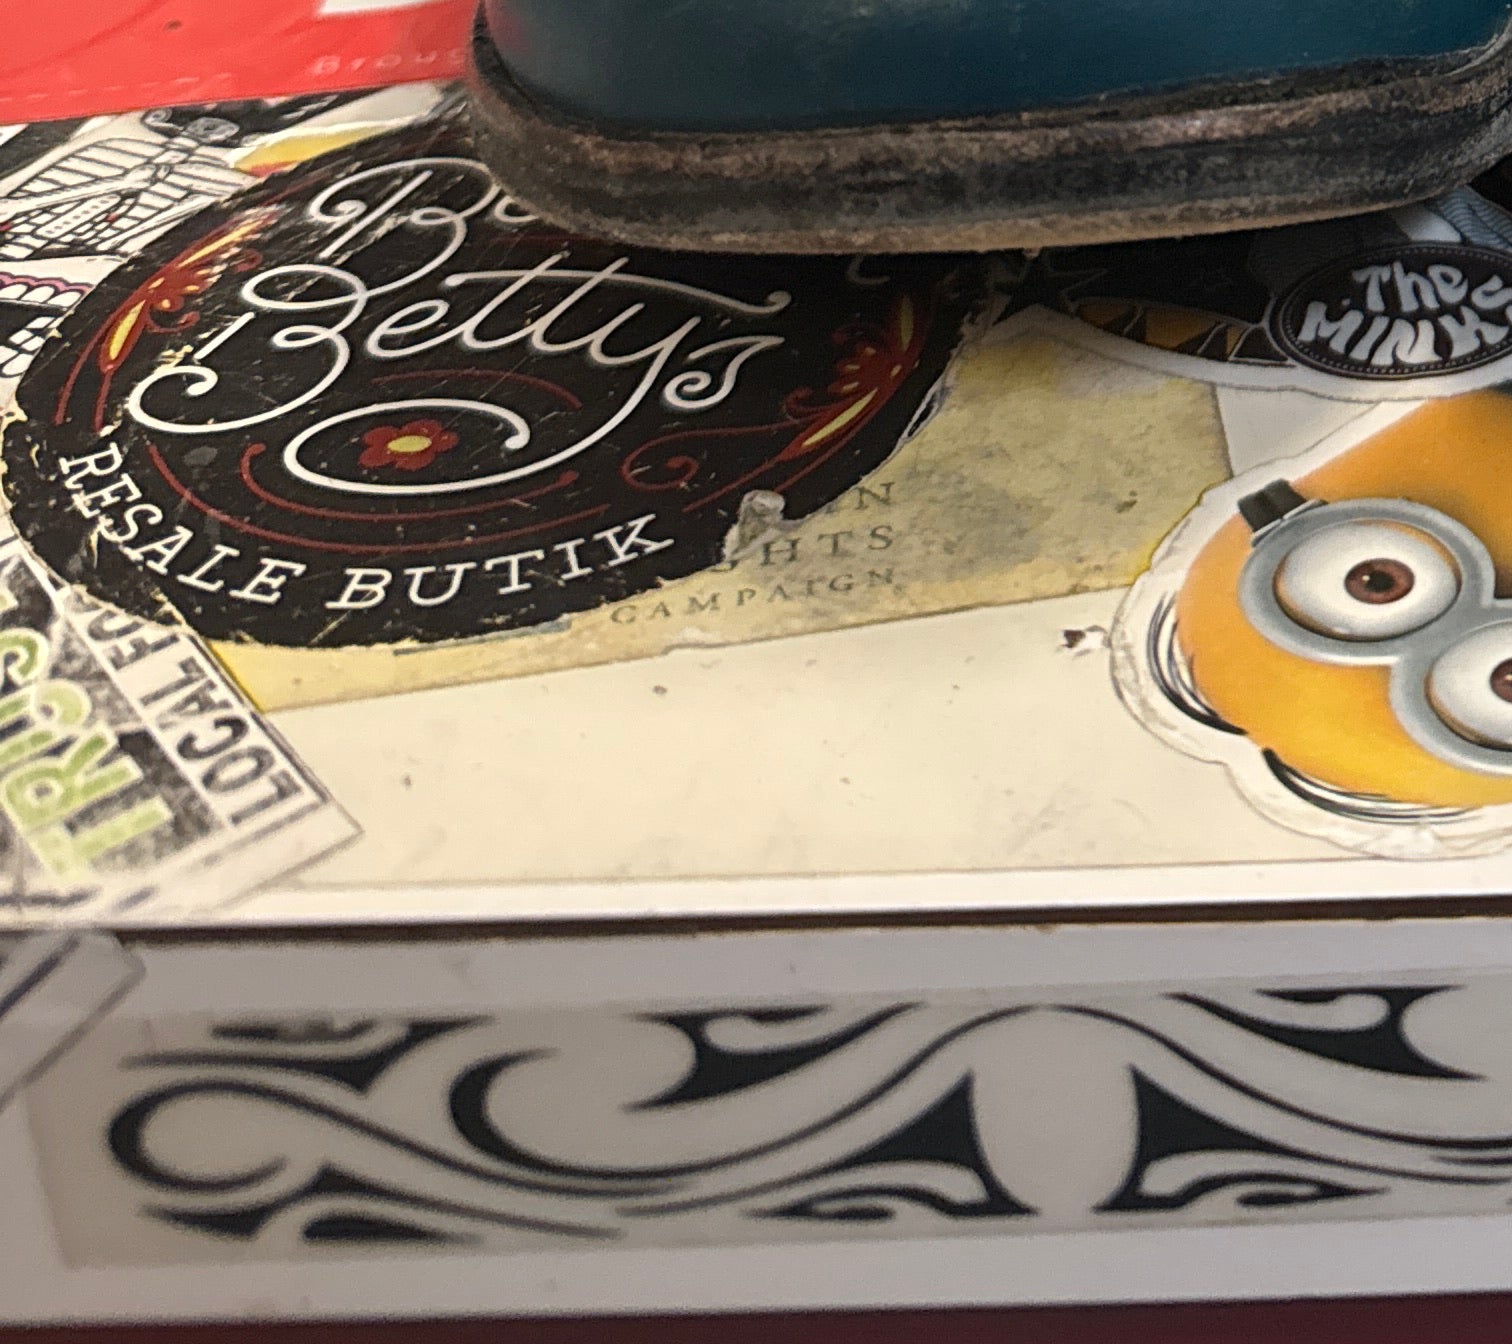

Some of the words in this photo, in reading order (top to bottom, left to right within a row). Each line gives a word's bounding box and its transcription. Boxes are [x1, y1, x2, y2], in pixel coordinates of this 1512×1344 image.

[1353, 262, 1470, 313] The
[59, 440, 306, 605] RESALE
[325, 512, 676, 611] BUTIK
[609, 566, 895, 625] CAMPAIGN
[138, 656, 305, 826] LOCAL
